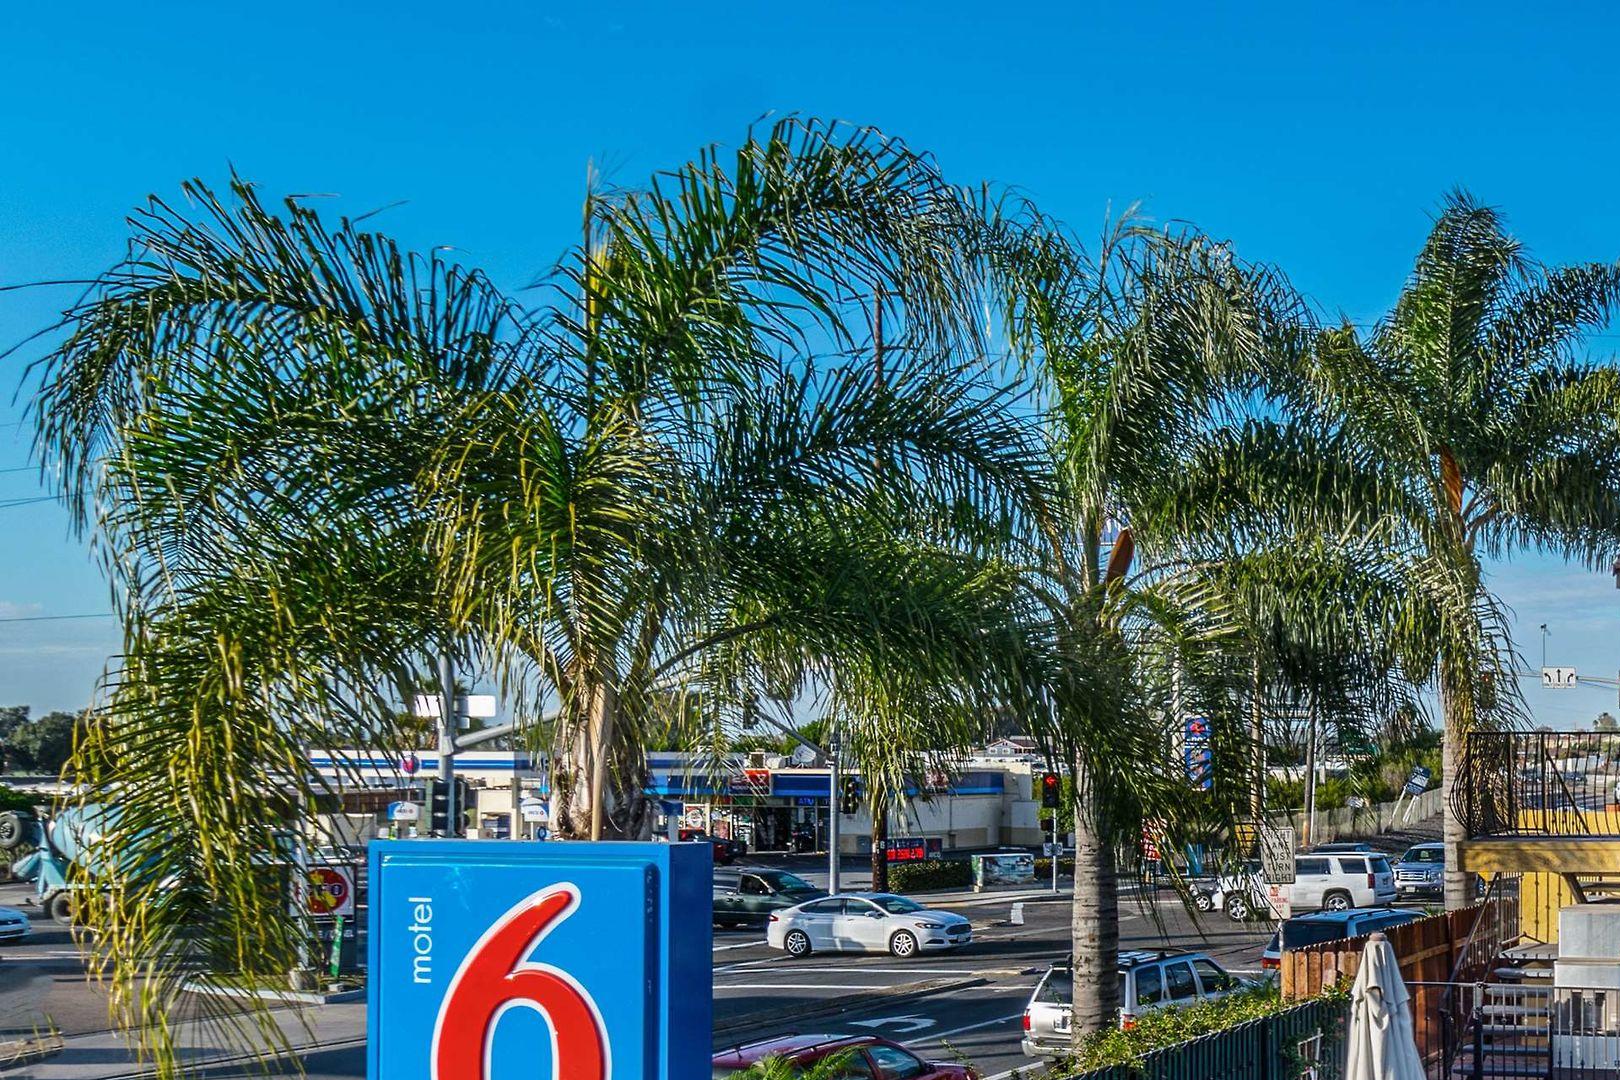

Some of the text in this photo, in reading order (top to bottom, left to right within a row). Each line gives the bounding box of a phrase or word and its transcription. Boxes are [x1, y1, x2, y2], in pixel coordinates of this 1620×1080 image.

[1267, 863, 1291, 871] TURN
[1265, 874, 1291, 882] RIGHT
[408, 897, 432, 984] motel
